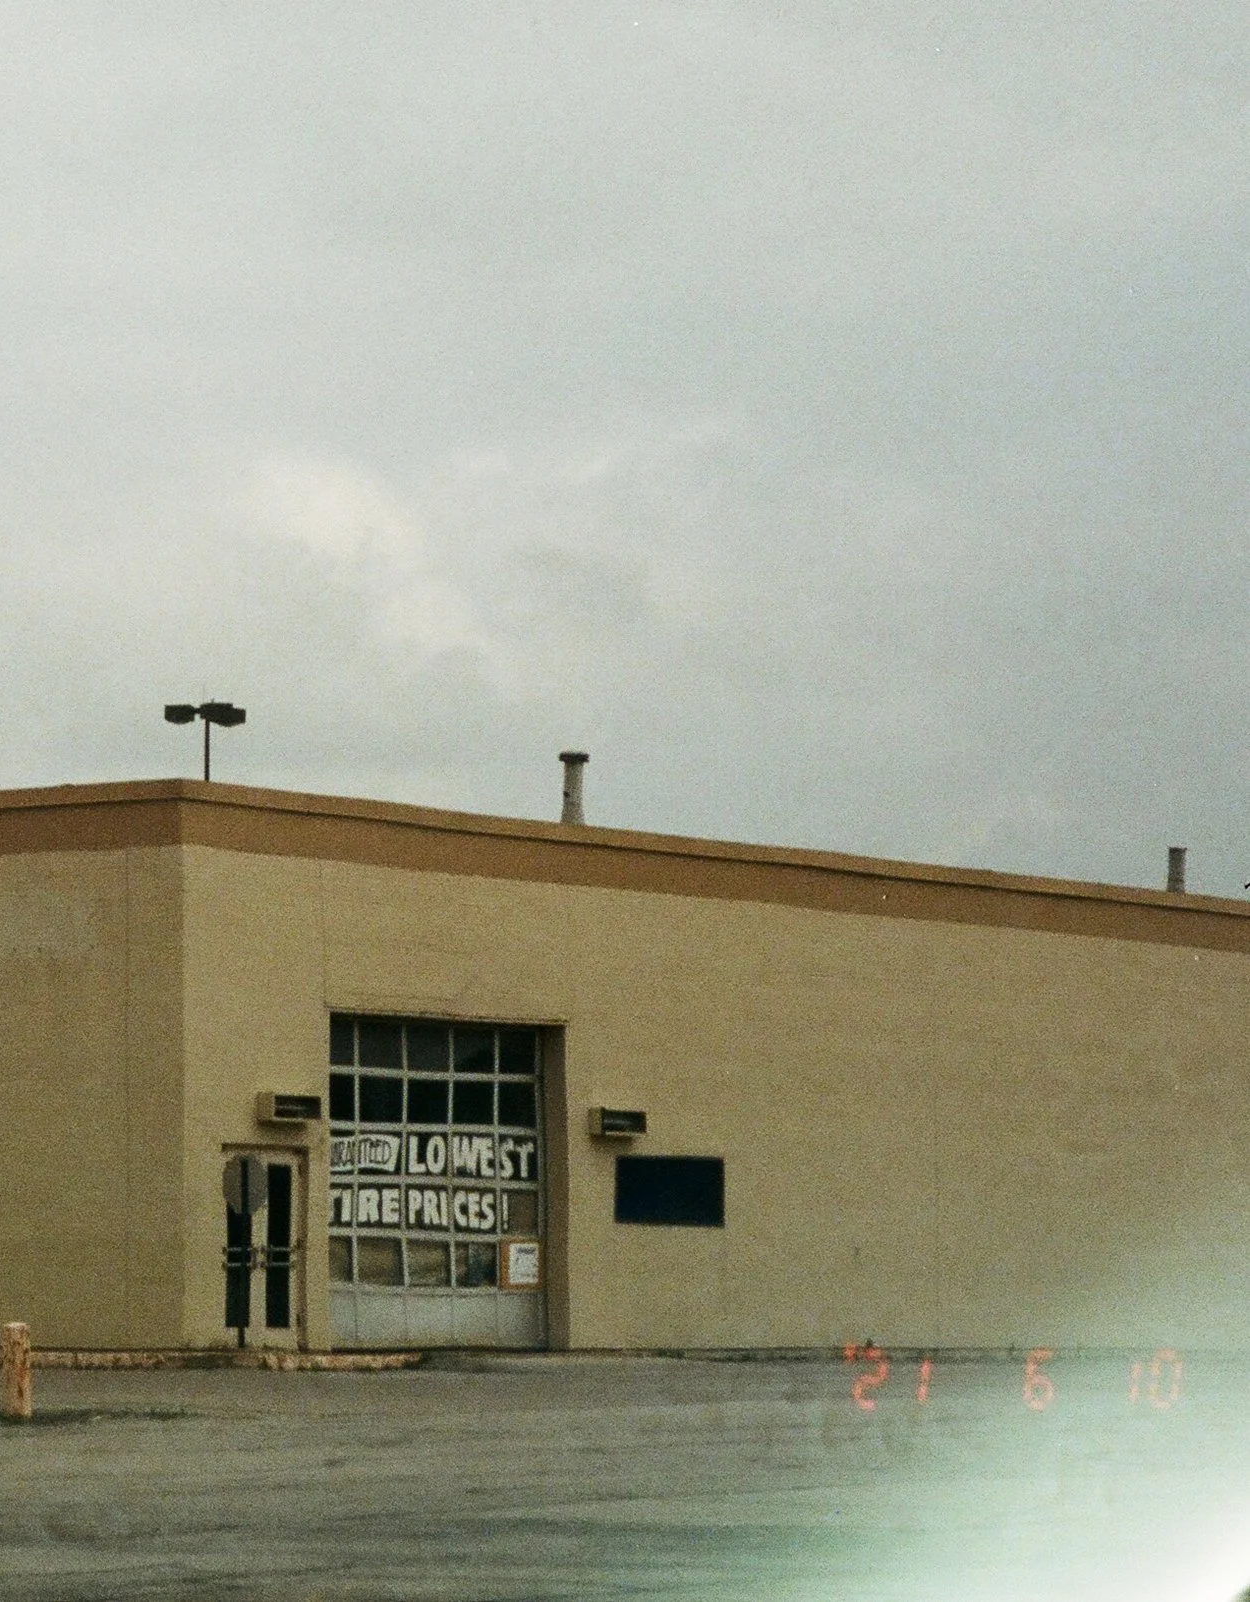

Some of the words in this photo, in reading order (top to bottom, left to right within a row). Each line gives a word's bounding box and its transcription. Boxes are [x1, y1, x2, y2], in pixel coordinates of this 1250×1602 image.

[408, 1135, 534, 1179] LOWEST
[329, 1188, 400, 1224] TIRE
[408, 1189, 508, 1231] PRICES!
